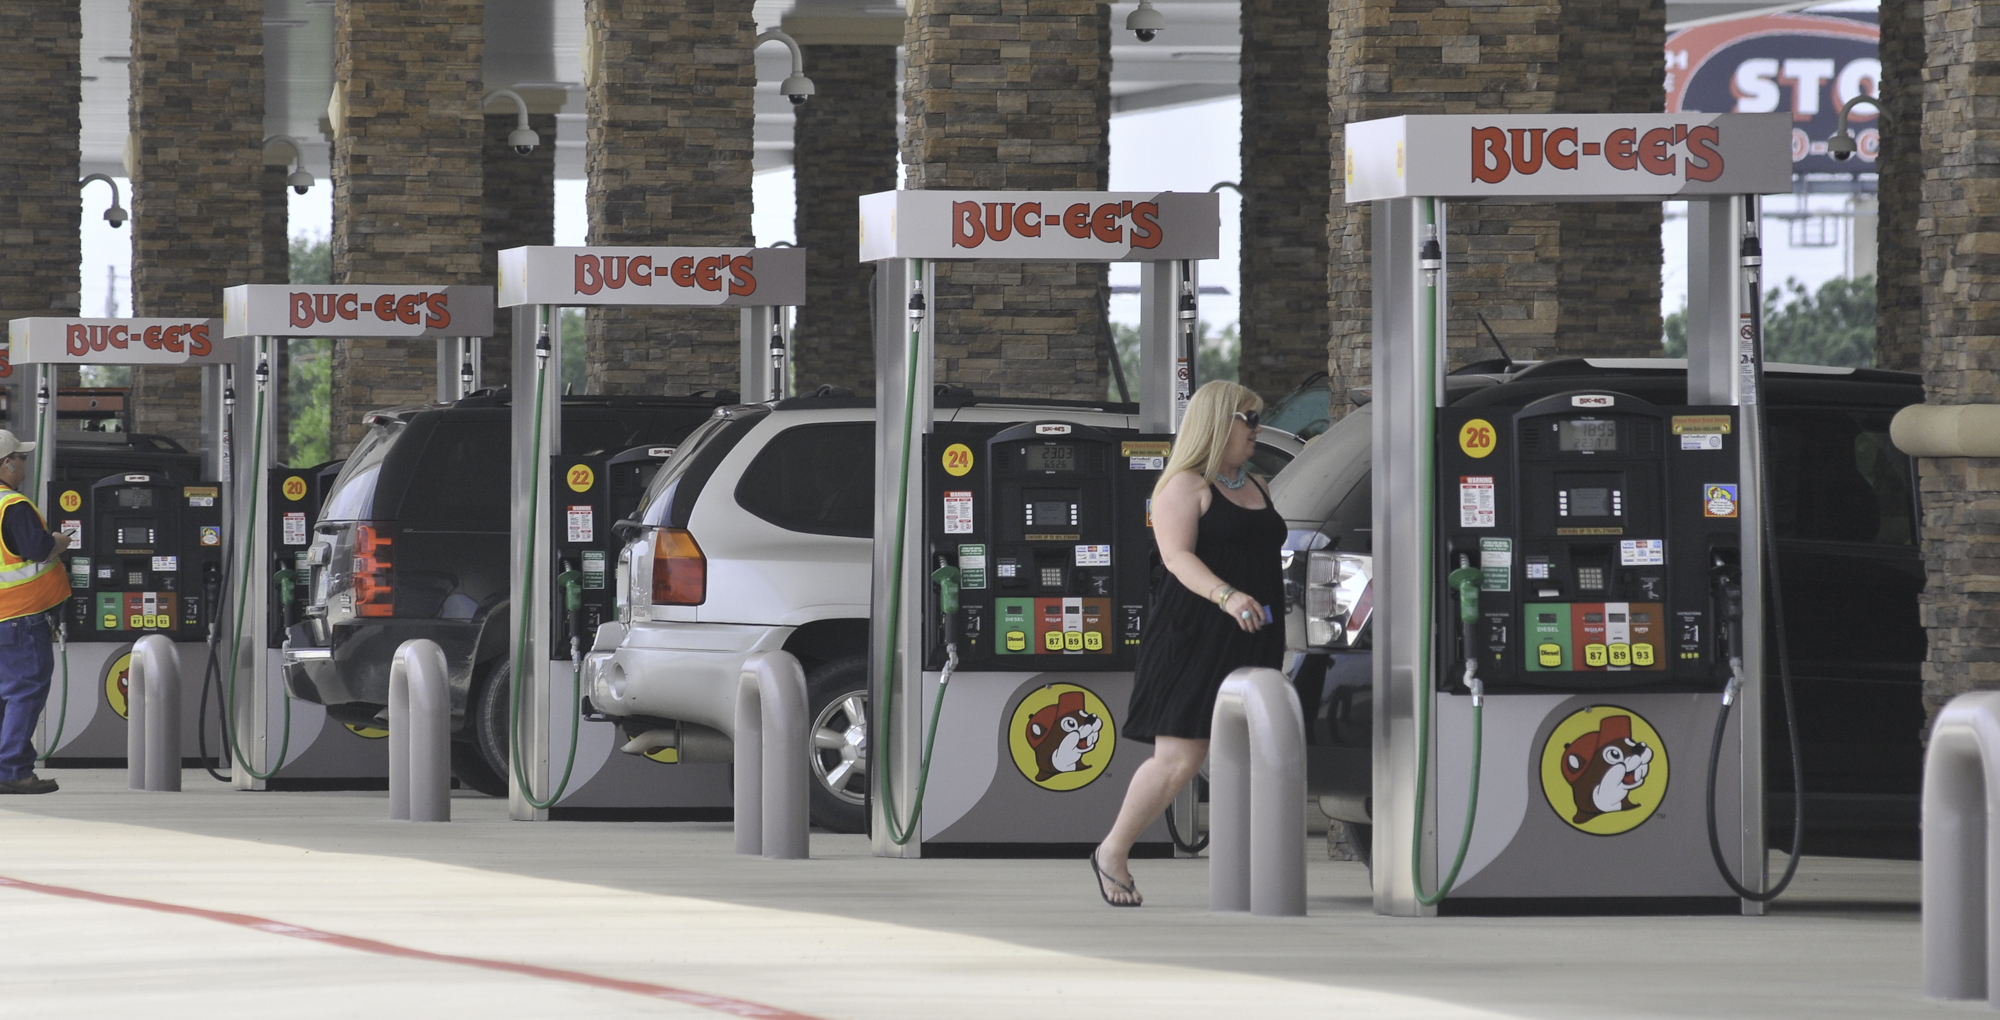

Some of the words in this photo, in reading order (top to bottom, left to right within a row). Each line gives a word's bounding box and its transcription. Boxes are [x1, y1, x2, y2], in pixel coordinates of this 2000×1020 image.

[1471, 124, 1725, 184] BUC-EE'S
[951, 200, 1163, 249] BUC-EE'S
[574, 254, 757, 296] BUC-EE'S
[289, 292, 451, 329] BUC-EE'S
[66, 323, 212, 357] BUC-EE'S
[1466, 427, 1490, 448] 26
[948, 451, 968, 467] 24
[287, 481, 303, 494] 20
[572, 470, 589, 485] 22
[64, 495, 77, 506] 18
[1590, 652, 1602, 660] 87
